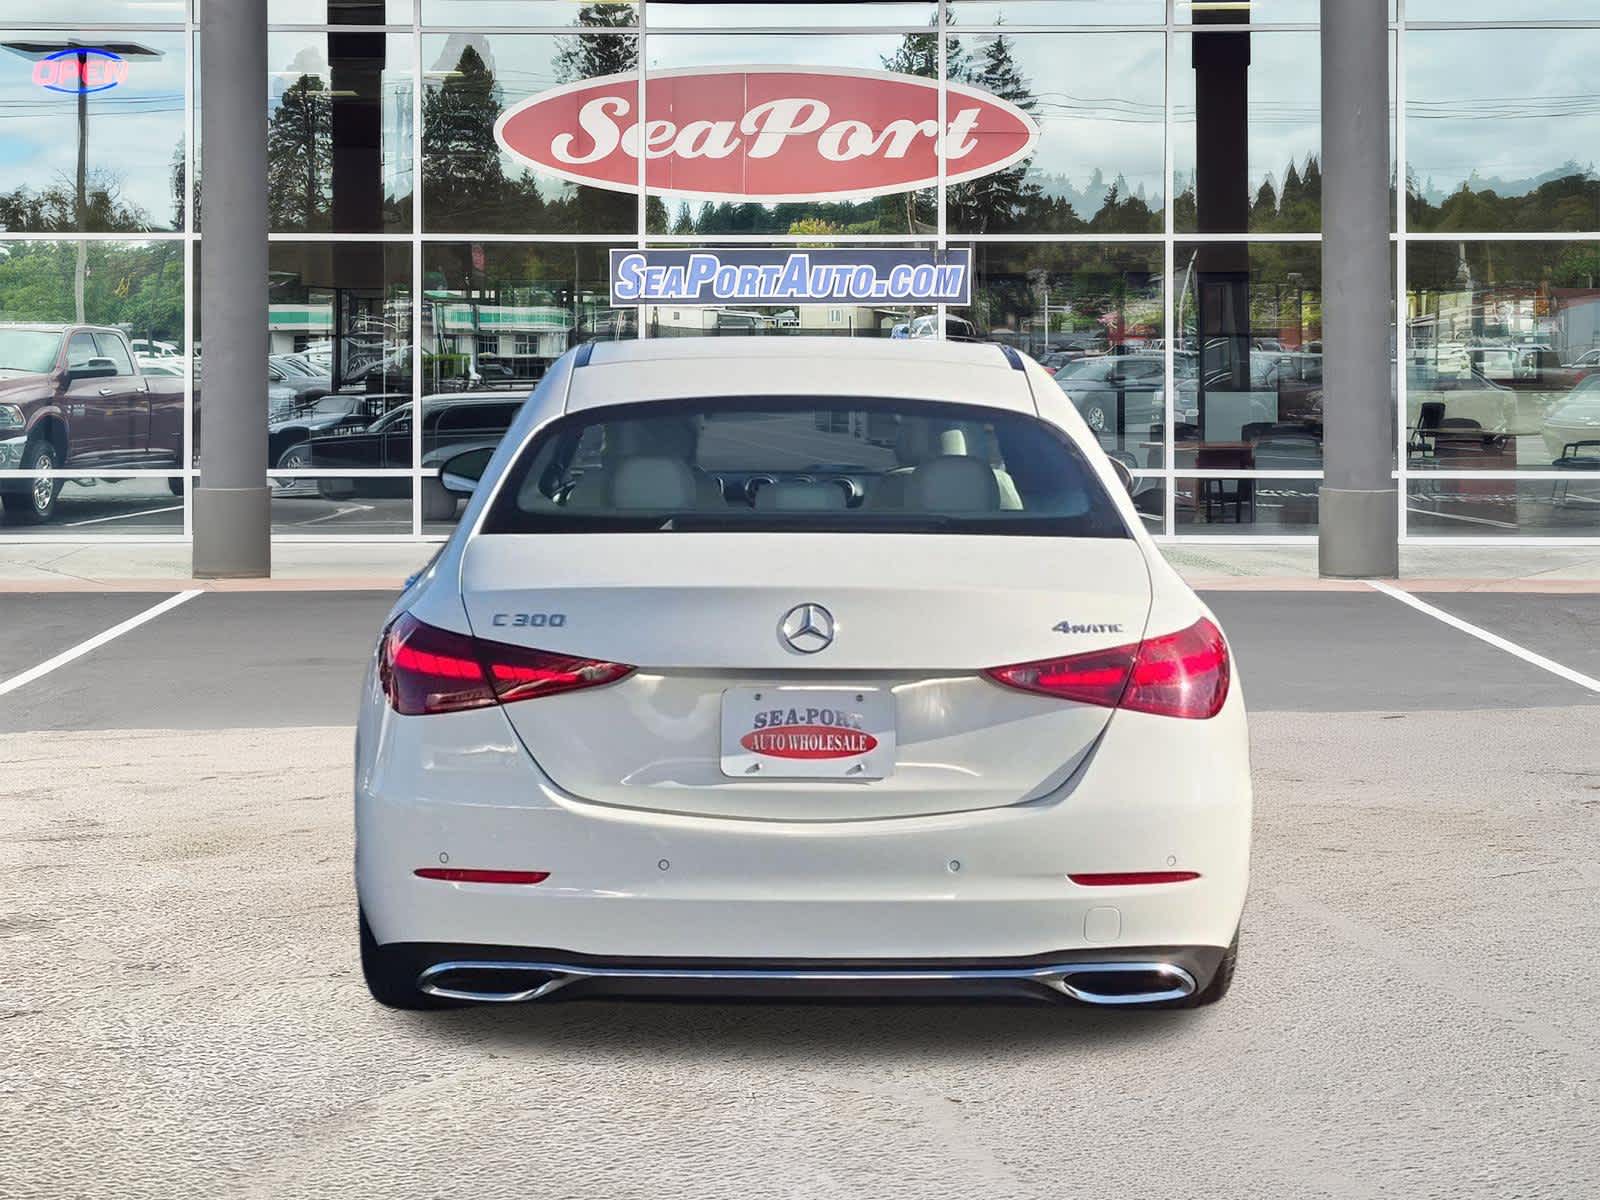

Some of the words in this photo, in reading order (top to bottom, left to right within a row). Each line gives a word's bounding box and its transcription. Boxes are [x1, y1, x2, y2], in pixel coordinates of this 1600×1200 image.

[32, 59, 128, 87] OPEN
[551, 95, 980, 165] SeaPort
[492, 613, 508, 627] C
[511, 613, 567, 628] 300
[1051, 620, 1124, 634] 4MATIC
[751, 733, 786, 751] AUTO
[788, 733, 867, 751] WHOLESALE
